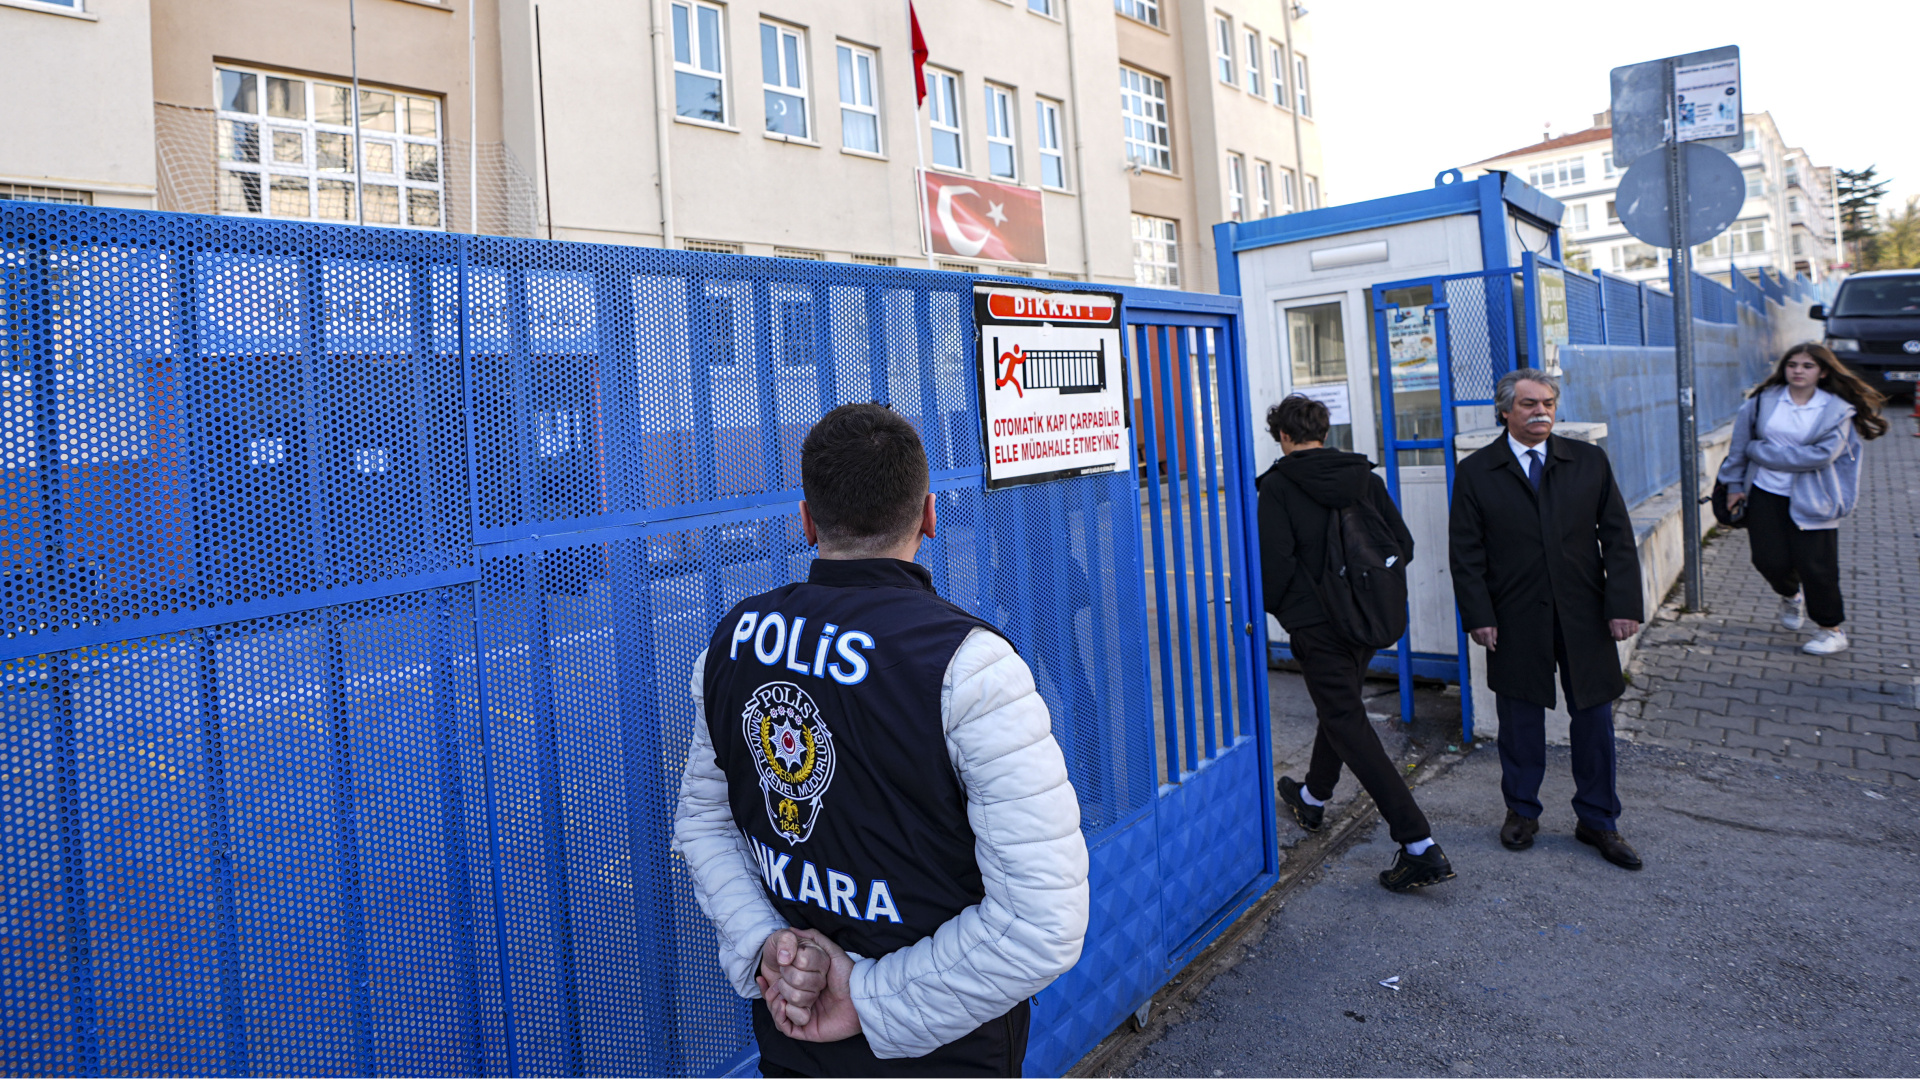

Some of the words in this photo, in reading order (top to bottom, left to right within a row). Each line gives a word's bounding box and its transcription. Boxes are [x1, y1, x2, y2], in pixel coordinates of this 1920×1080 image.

[994, 411, 1044, 437] OTOMATİK
[1046, 414, 1067, 432] KAPI
[1070, 406, 1120, 435] ÇARPABİLİR
[994, 444, 1019, 464] ELLE
[1021, 438, 1071, 461] MÜDAHALE
[1073, 430, 1120, 456] ETMEYİNİZ
[758, 686, 812, 719] POLİS
[765, 766, 796, 797] GENEL
[779, 819, 801, 835] 1845
[743, 828, 903, 924] NKARA
